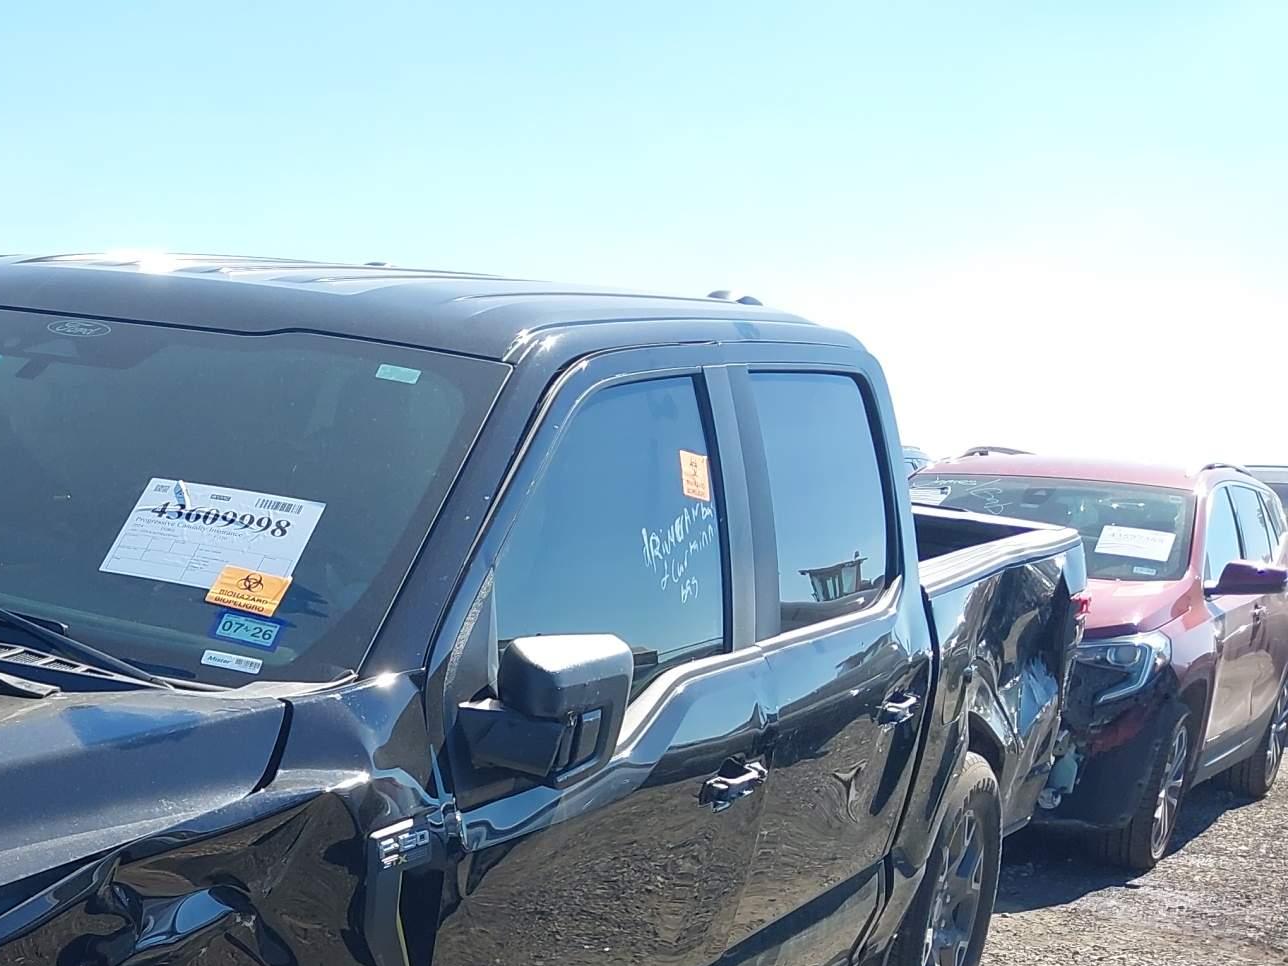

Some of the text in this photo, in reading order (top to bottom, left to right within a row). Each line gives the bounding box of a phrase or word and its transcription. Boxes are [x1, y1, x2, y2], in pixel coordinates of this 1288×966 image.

[56, 320, 101, 336] Ford
[135, 516, 175, 528] Progressive
[176, 520, 208, 534] Casualty
[209, 526, 244, 538] Insurance
[151, 502, 292, 538] 43609998
[214, 596, 265, 612] BIOPELIGRO
[218, 589, 269, 605] BIOHAZARD
[207, 655, 232, 665] Mister
